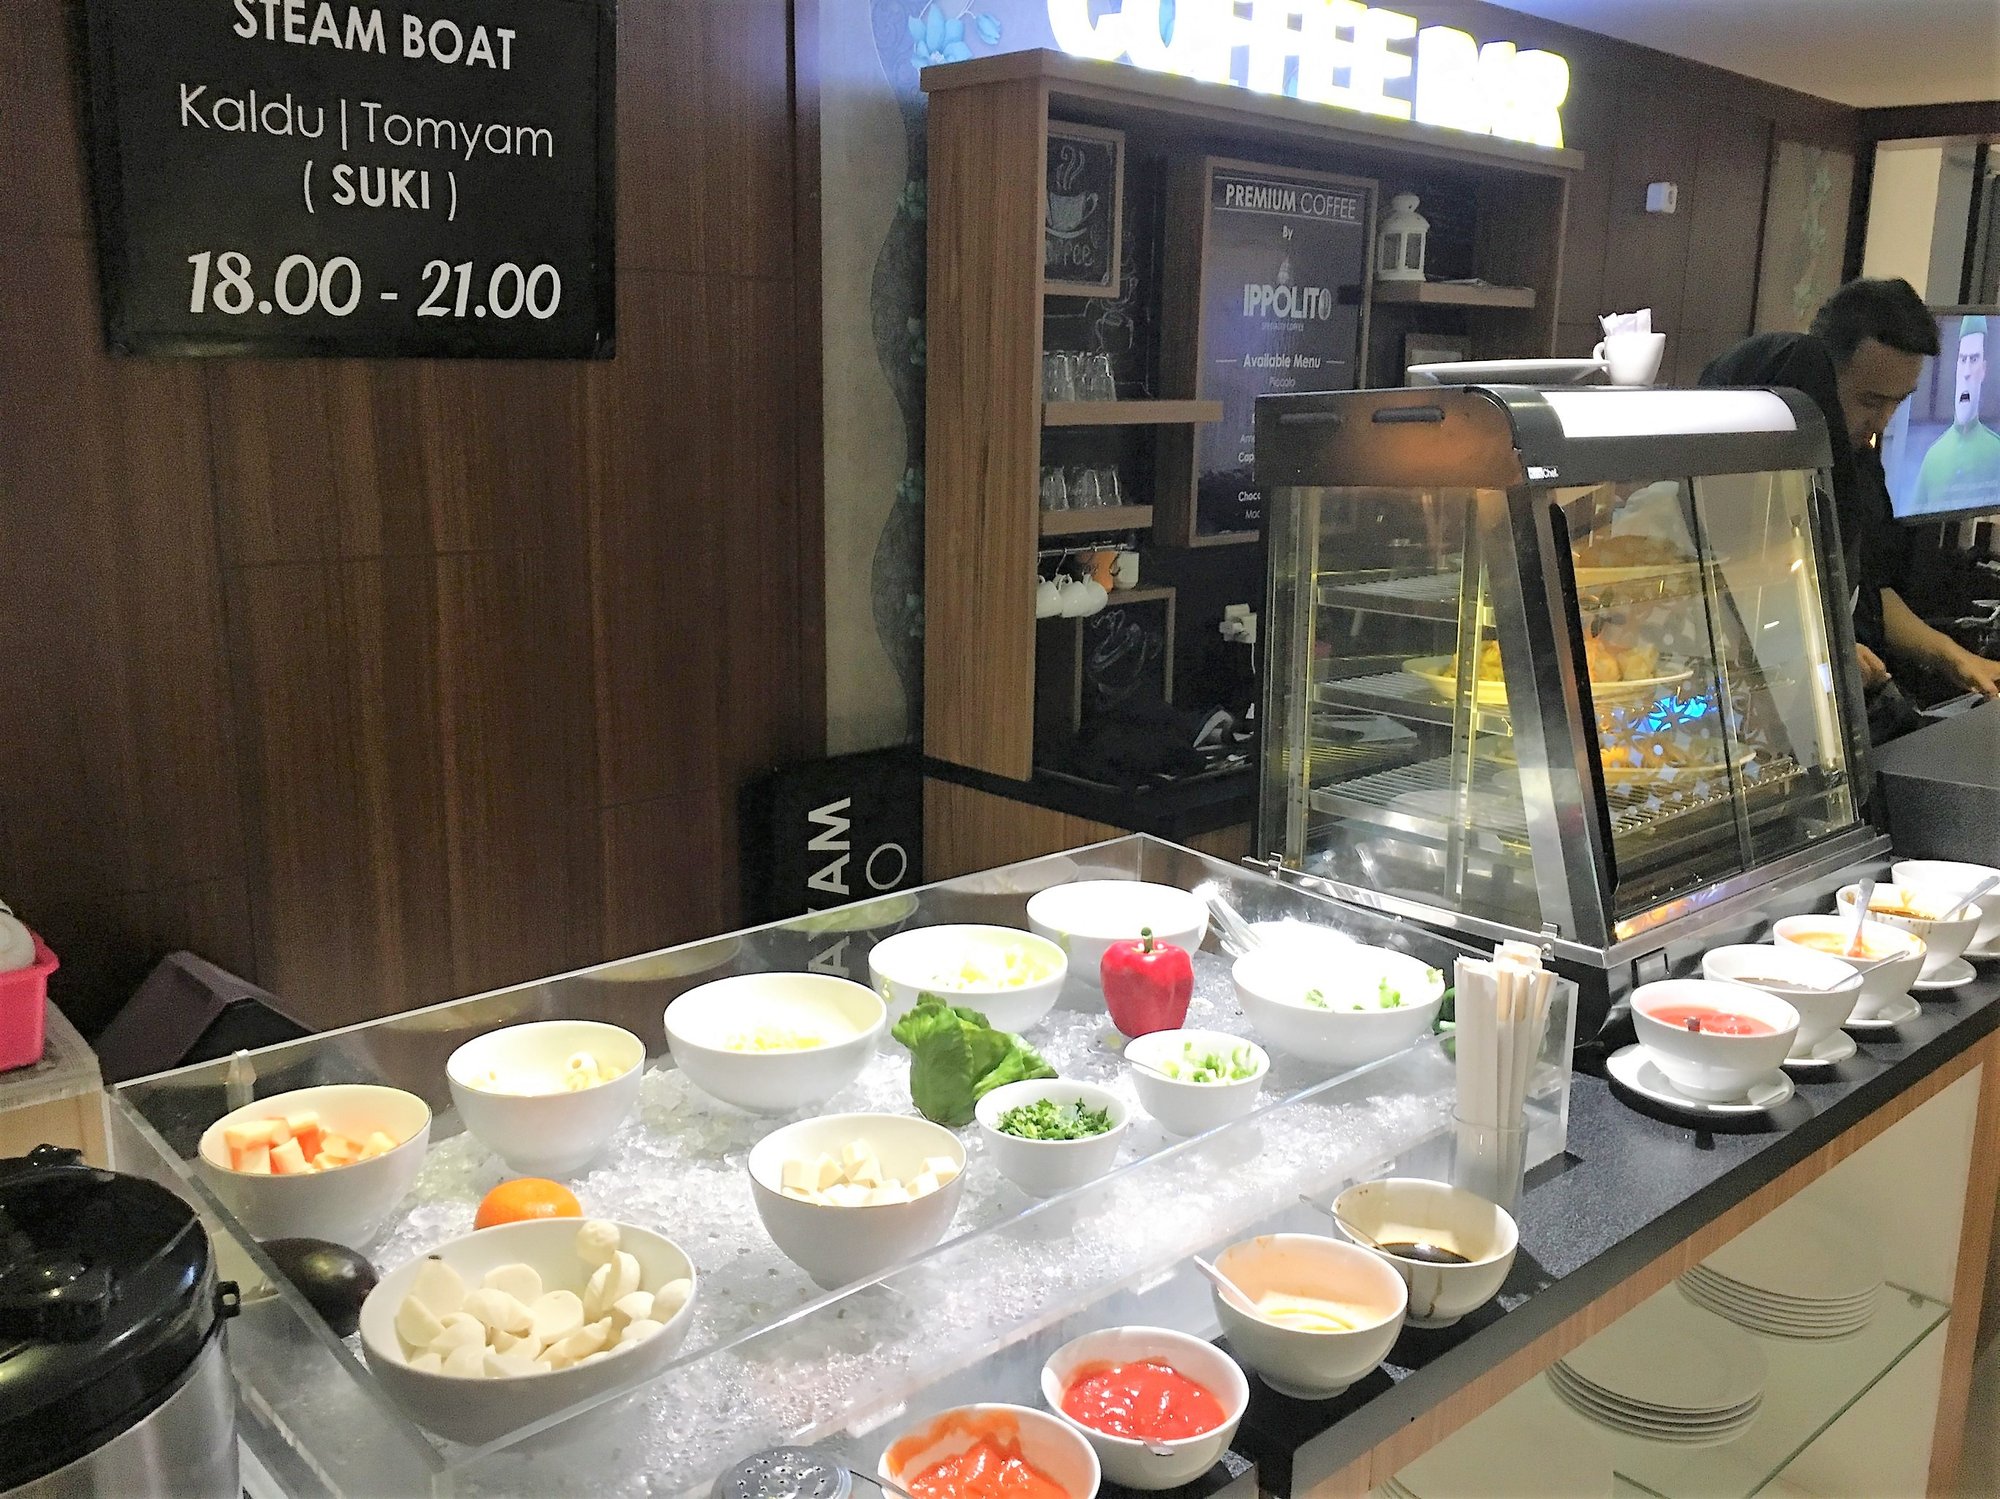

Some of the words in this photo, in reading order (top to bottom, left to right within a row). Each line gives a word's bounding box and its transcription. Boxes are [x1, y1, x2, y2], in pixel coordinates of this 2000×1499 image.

[232, 0, 387, 54] STEAM
[402, 14, 516, 70] BOAT
[1048, 0, 1418, 120] COFFEE
[180, 83, 324, 138] Kaldu
[360, 102, 553, 161] Tomyam
[332, 164, 430, 209] SUKI
[1226, 183, 1296, 212] PREMIUM
[1300, 192, 1356, 219] COFFEE
[1282, 225, 1293, 240] By
[187, 251, 361, 316] 18.00
[416, 260, 561, 319] 21.00
[1243, 283, 1332, 321] IPPOLITO
[1243, 353, 1291, 368] Available
[1293, 354, 1321, 369] Menu
[807, 797, 851, 979] AAM
